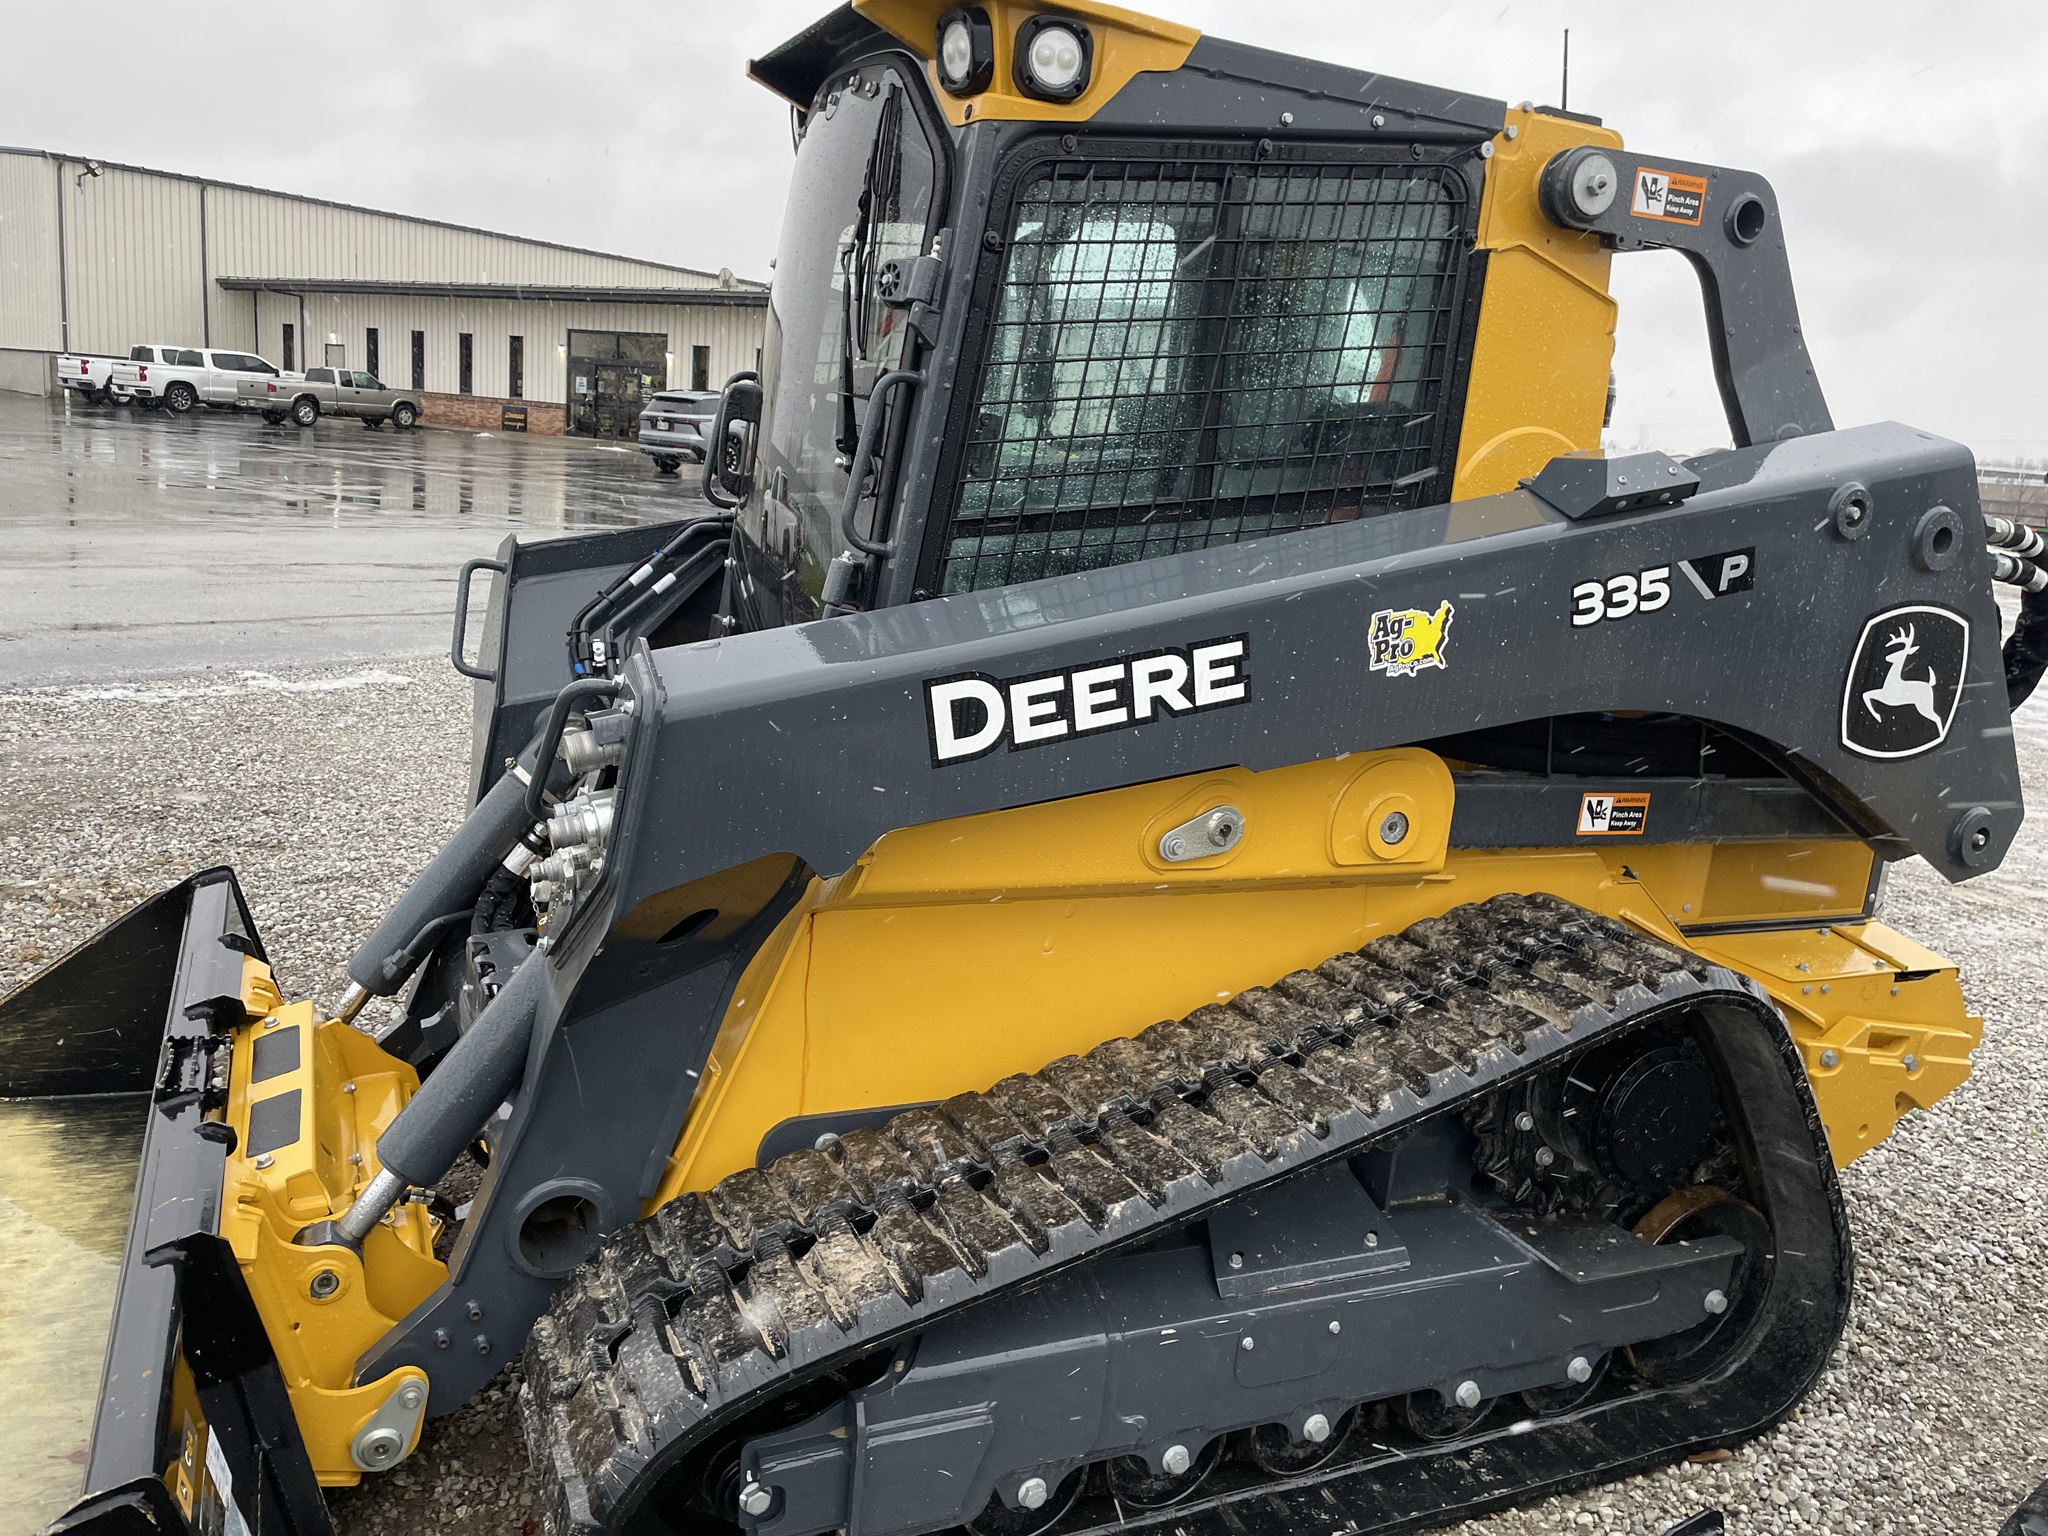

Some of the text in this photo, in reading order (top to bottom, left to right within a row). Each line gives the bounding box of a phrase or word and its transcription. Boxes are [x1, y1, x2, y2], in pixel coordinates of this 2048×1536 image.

[1677, 179, 1703, 189] WARNING
[1667, 194, 1699, 206] Pinch Area
[1666, 204, 1693, 216] Keep Away
[1572, 566, 1671, 626] 335
[1372, 614, 1413, 641] Ag-
[1373, 639, 1414, 665] Pro
[1388, 656, 1435, 674] AgProCo.com
[930, 640, 1246, 761] DEERE
[1612, 811, 1642, 819] Pinch Area
[1610, 820, 1637, 828] Keep Away
